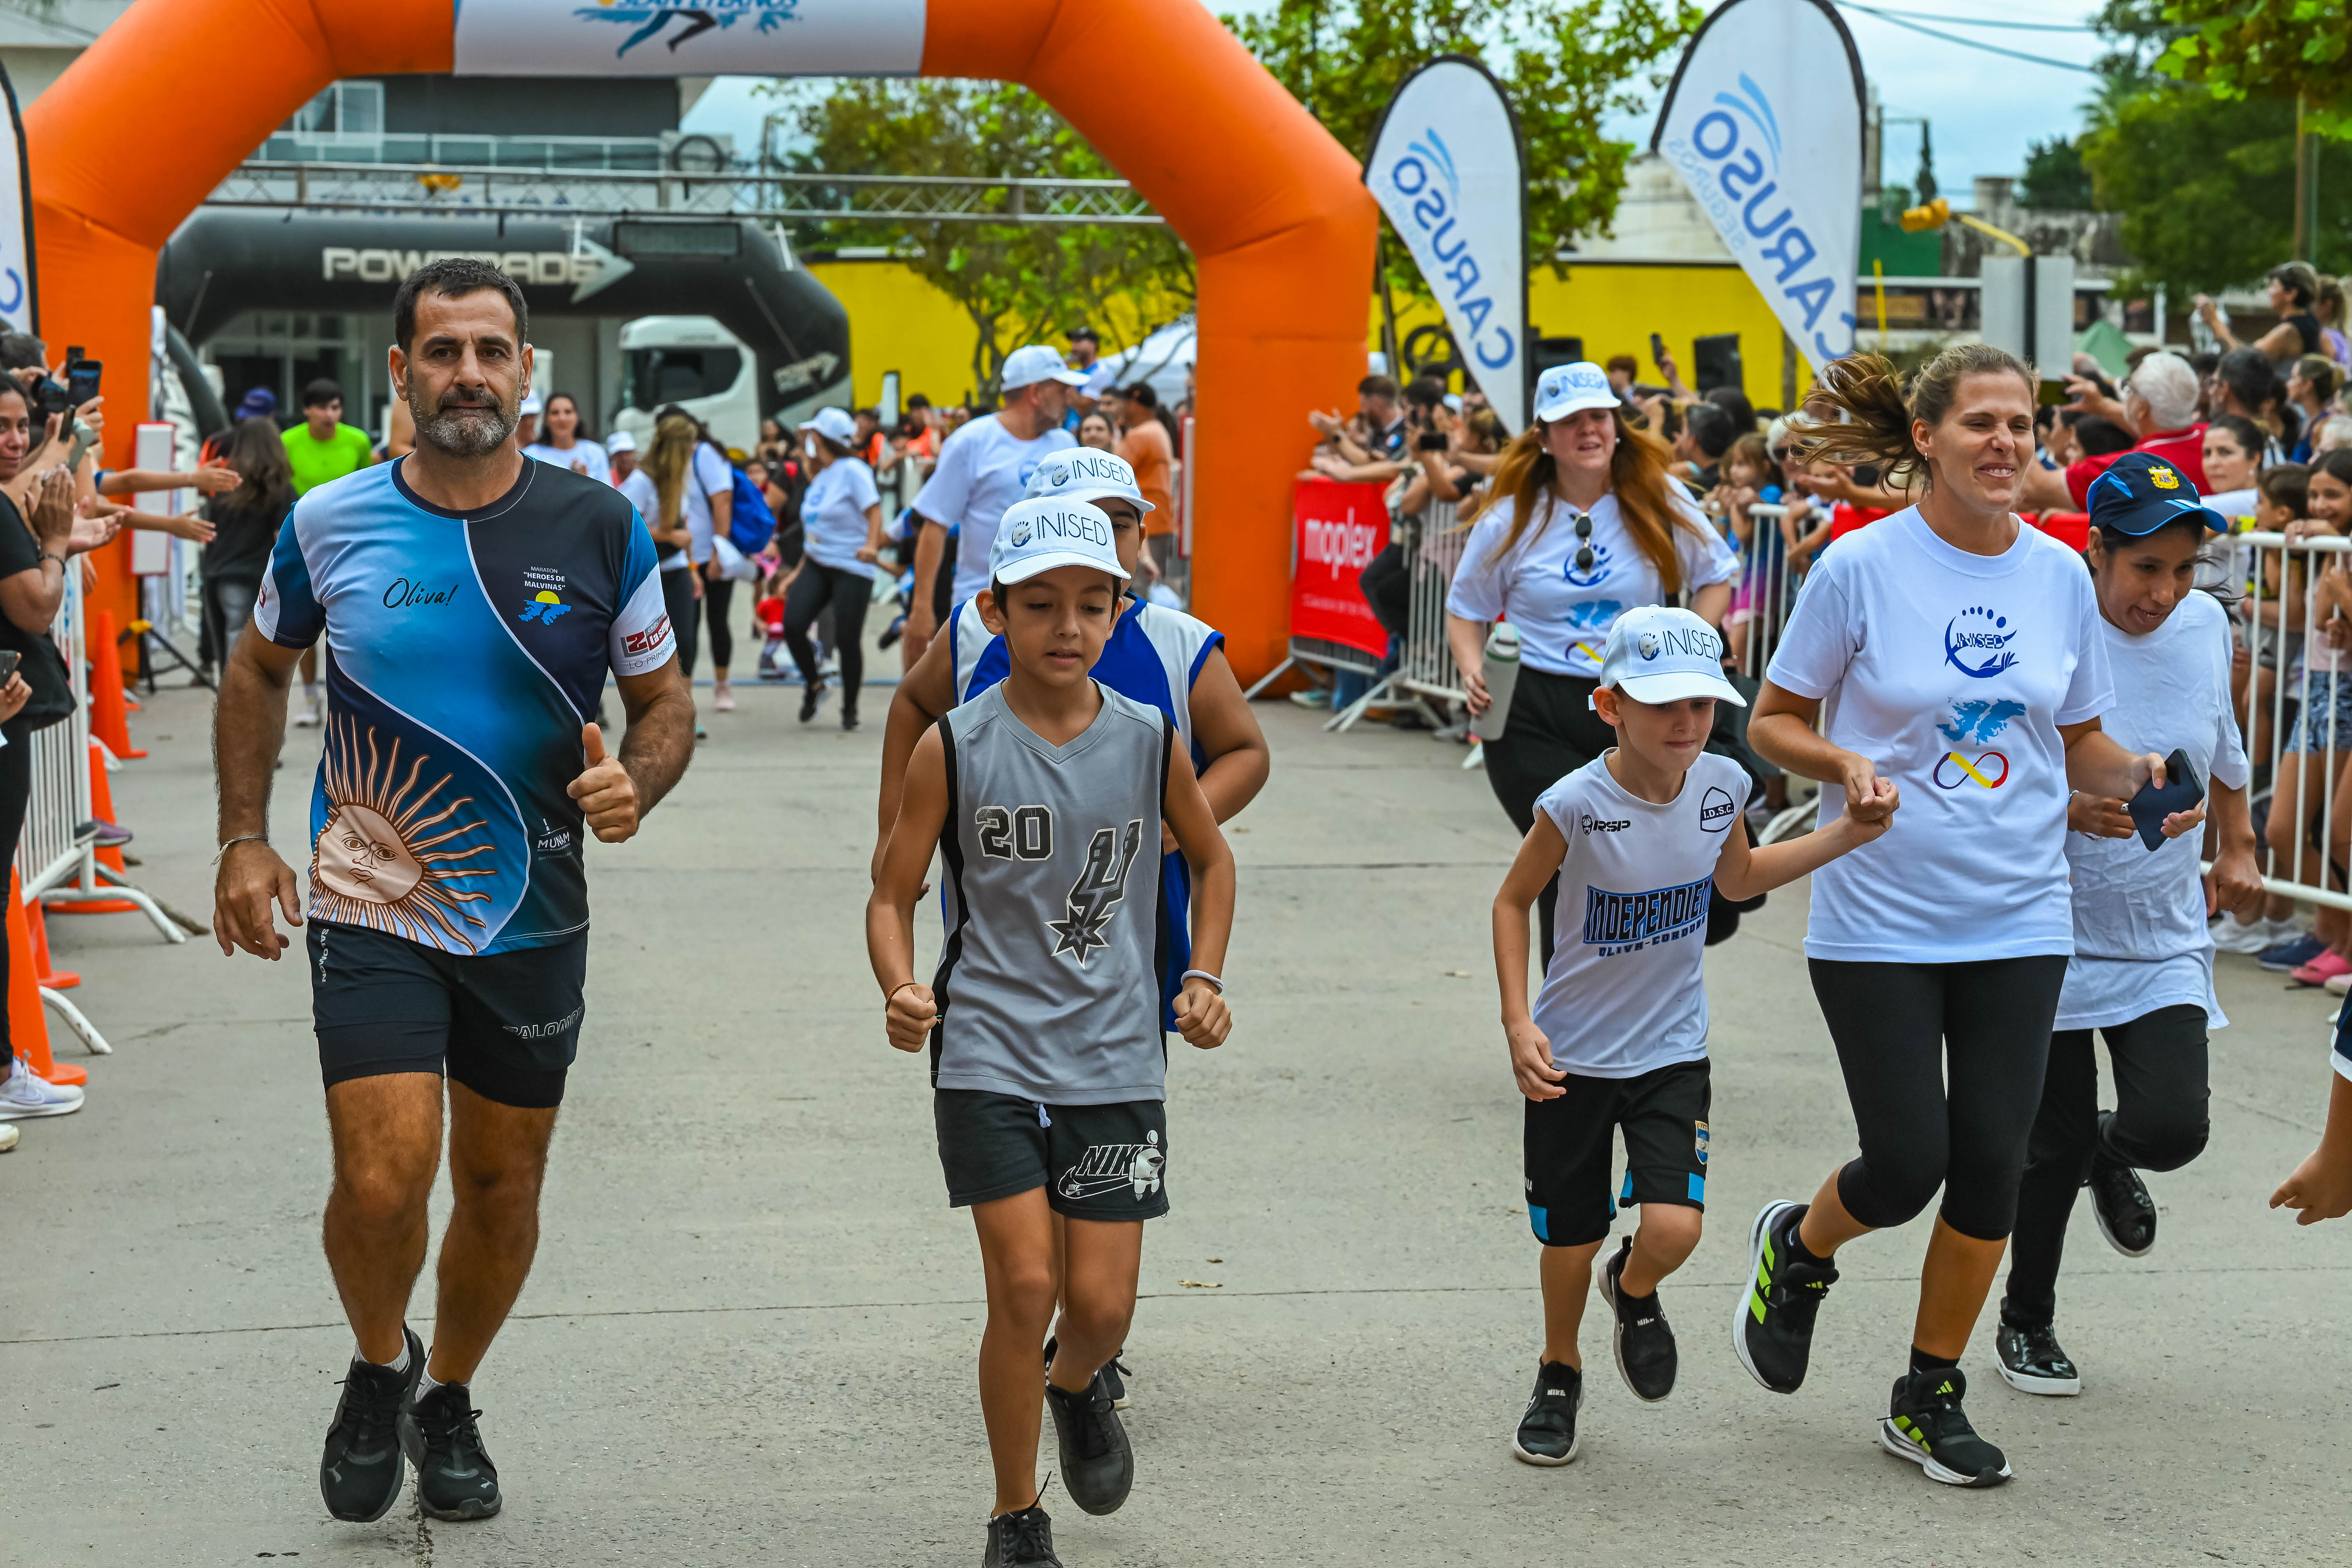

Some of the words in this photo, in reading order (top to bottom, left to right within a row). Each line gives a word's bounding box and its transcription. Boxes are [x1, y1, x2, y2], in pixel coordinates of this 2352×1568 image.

[1072, 457, 1132, 486] INISED
[1036, 512, 1107, 546] INISED
[383, 578, 459, 609] Oliva!
[629, 660, 643, 669] LO
[646, 642, 669, 665] PRIMERO
[1662, 628, 1723, 662] INISED
[1956, 632, 2005, 649] INISED
[1703, 807, 1733, 819] I.D.S.C.
[537, 831, 570, 848] MUNAM
[975, 804, 1054, 861] 20
[319, 928, 329, 982] SALOMON
